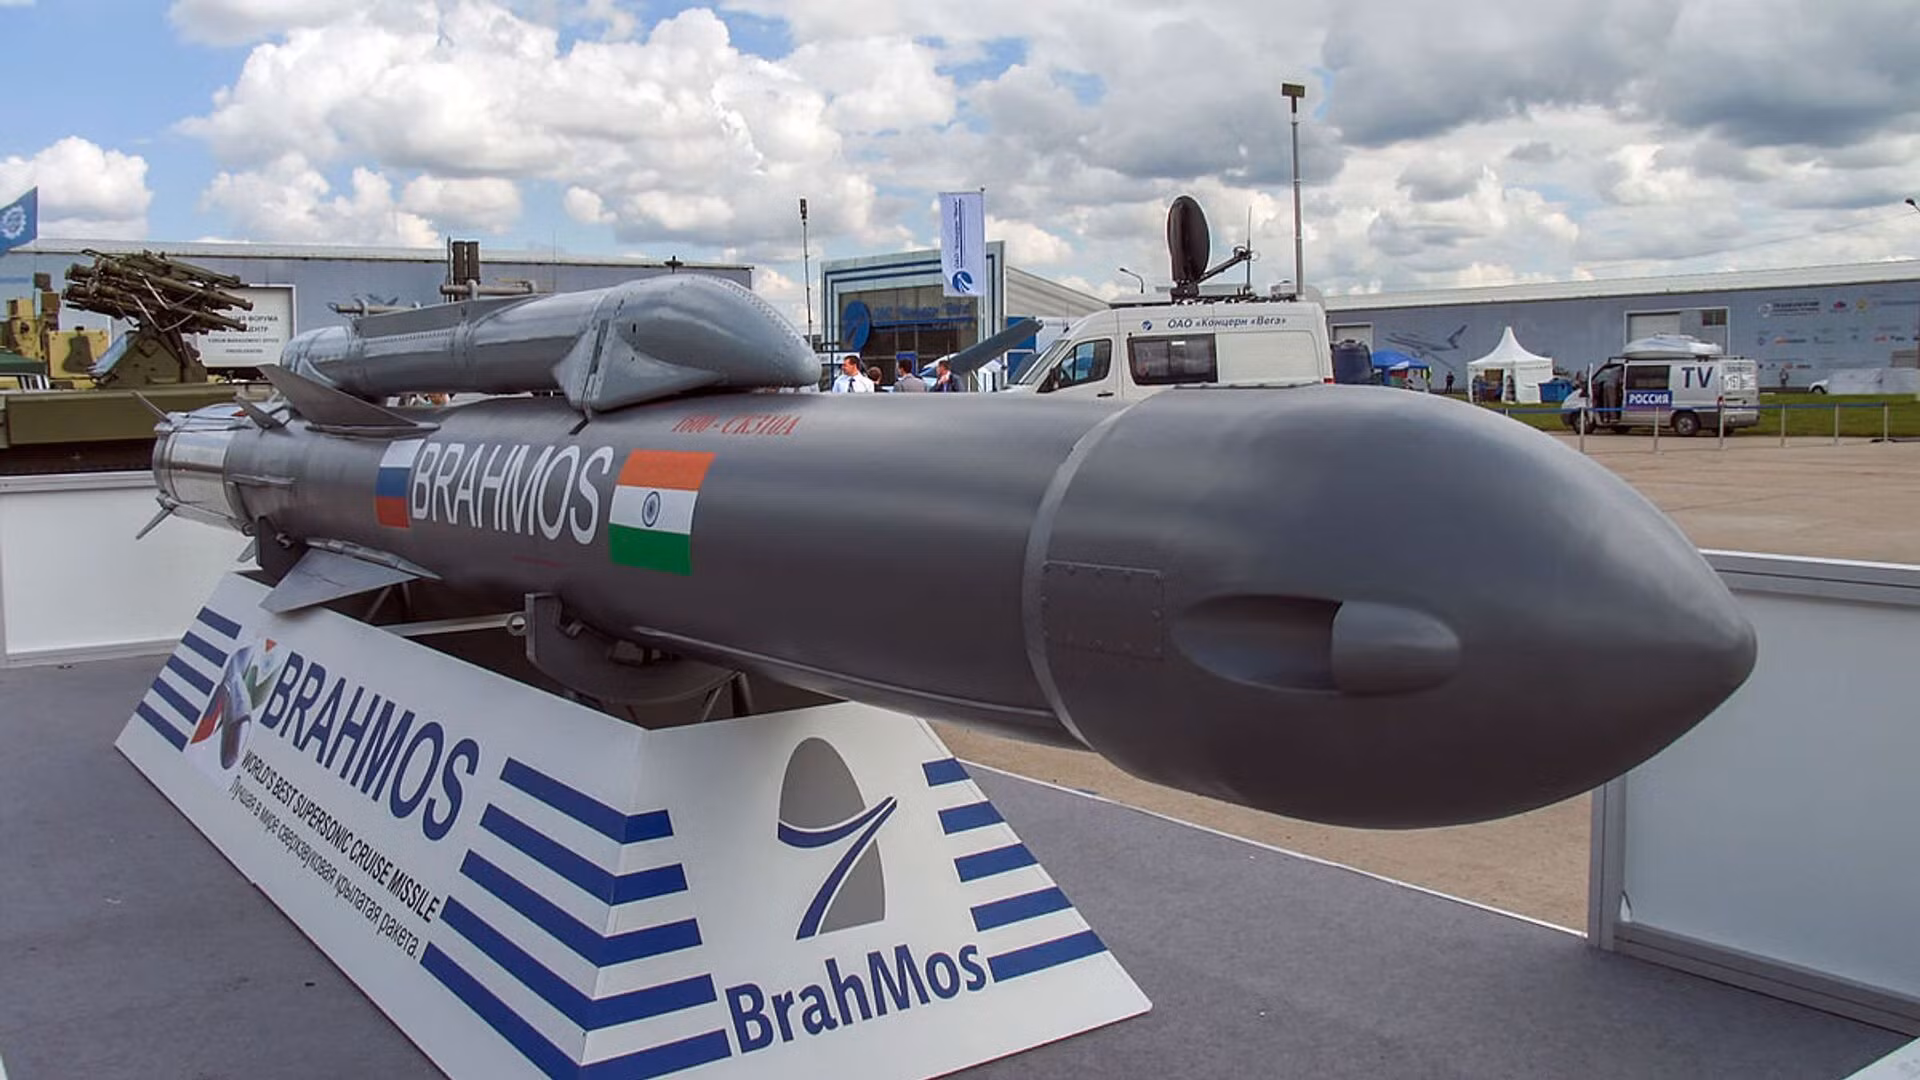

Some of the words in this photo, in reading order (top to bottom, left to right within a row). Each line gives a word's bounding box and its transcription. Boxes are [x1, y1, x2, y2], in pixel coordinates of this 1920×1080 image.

[1167, 318, 1193, 329] ОАО
[1628, 392, 1669, 405] РОССИЯ
[1681, 366, 1714, 388] TV
[411, 442, 614, 545] BRAHMOS
[259, 651, 479, 841] BRAHMOS
[241, 750, 277, 790] WORLD'S
[272, 777, 299, 807] BEST
[292, 794, 354, 853] SUPERSONIC
[349, 839, 393, 885] CRUISE
[387, 868, 440, 923] MISSILE
[335, 873, 382, 924] крылатая
[376, 912, 419, 960] ракета.
[725, 944, 986, 1053] BrahMos
